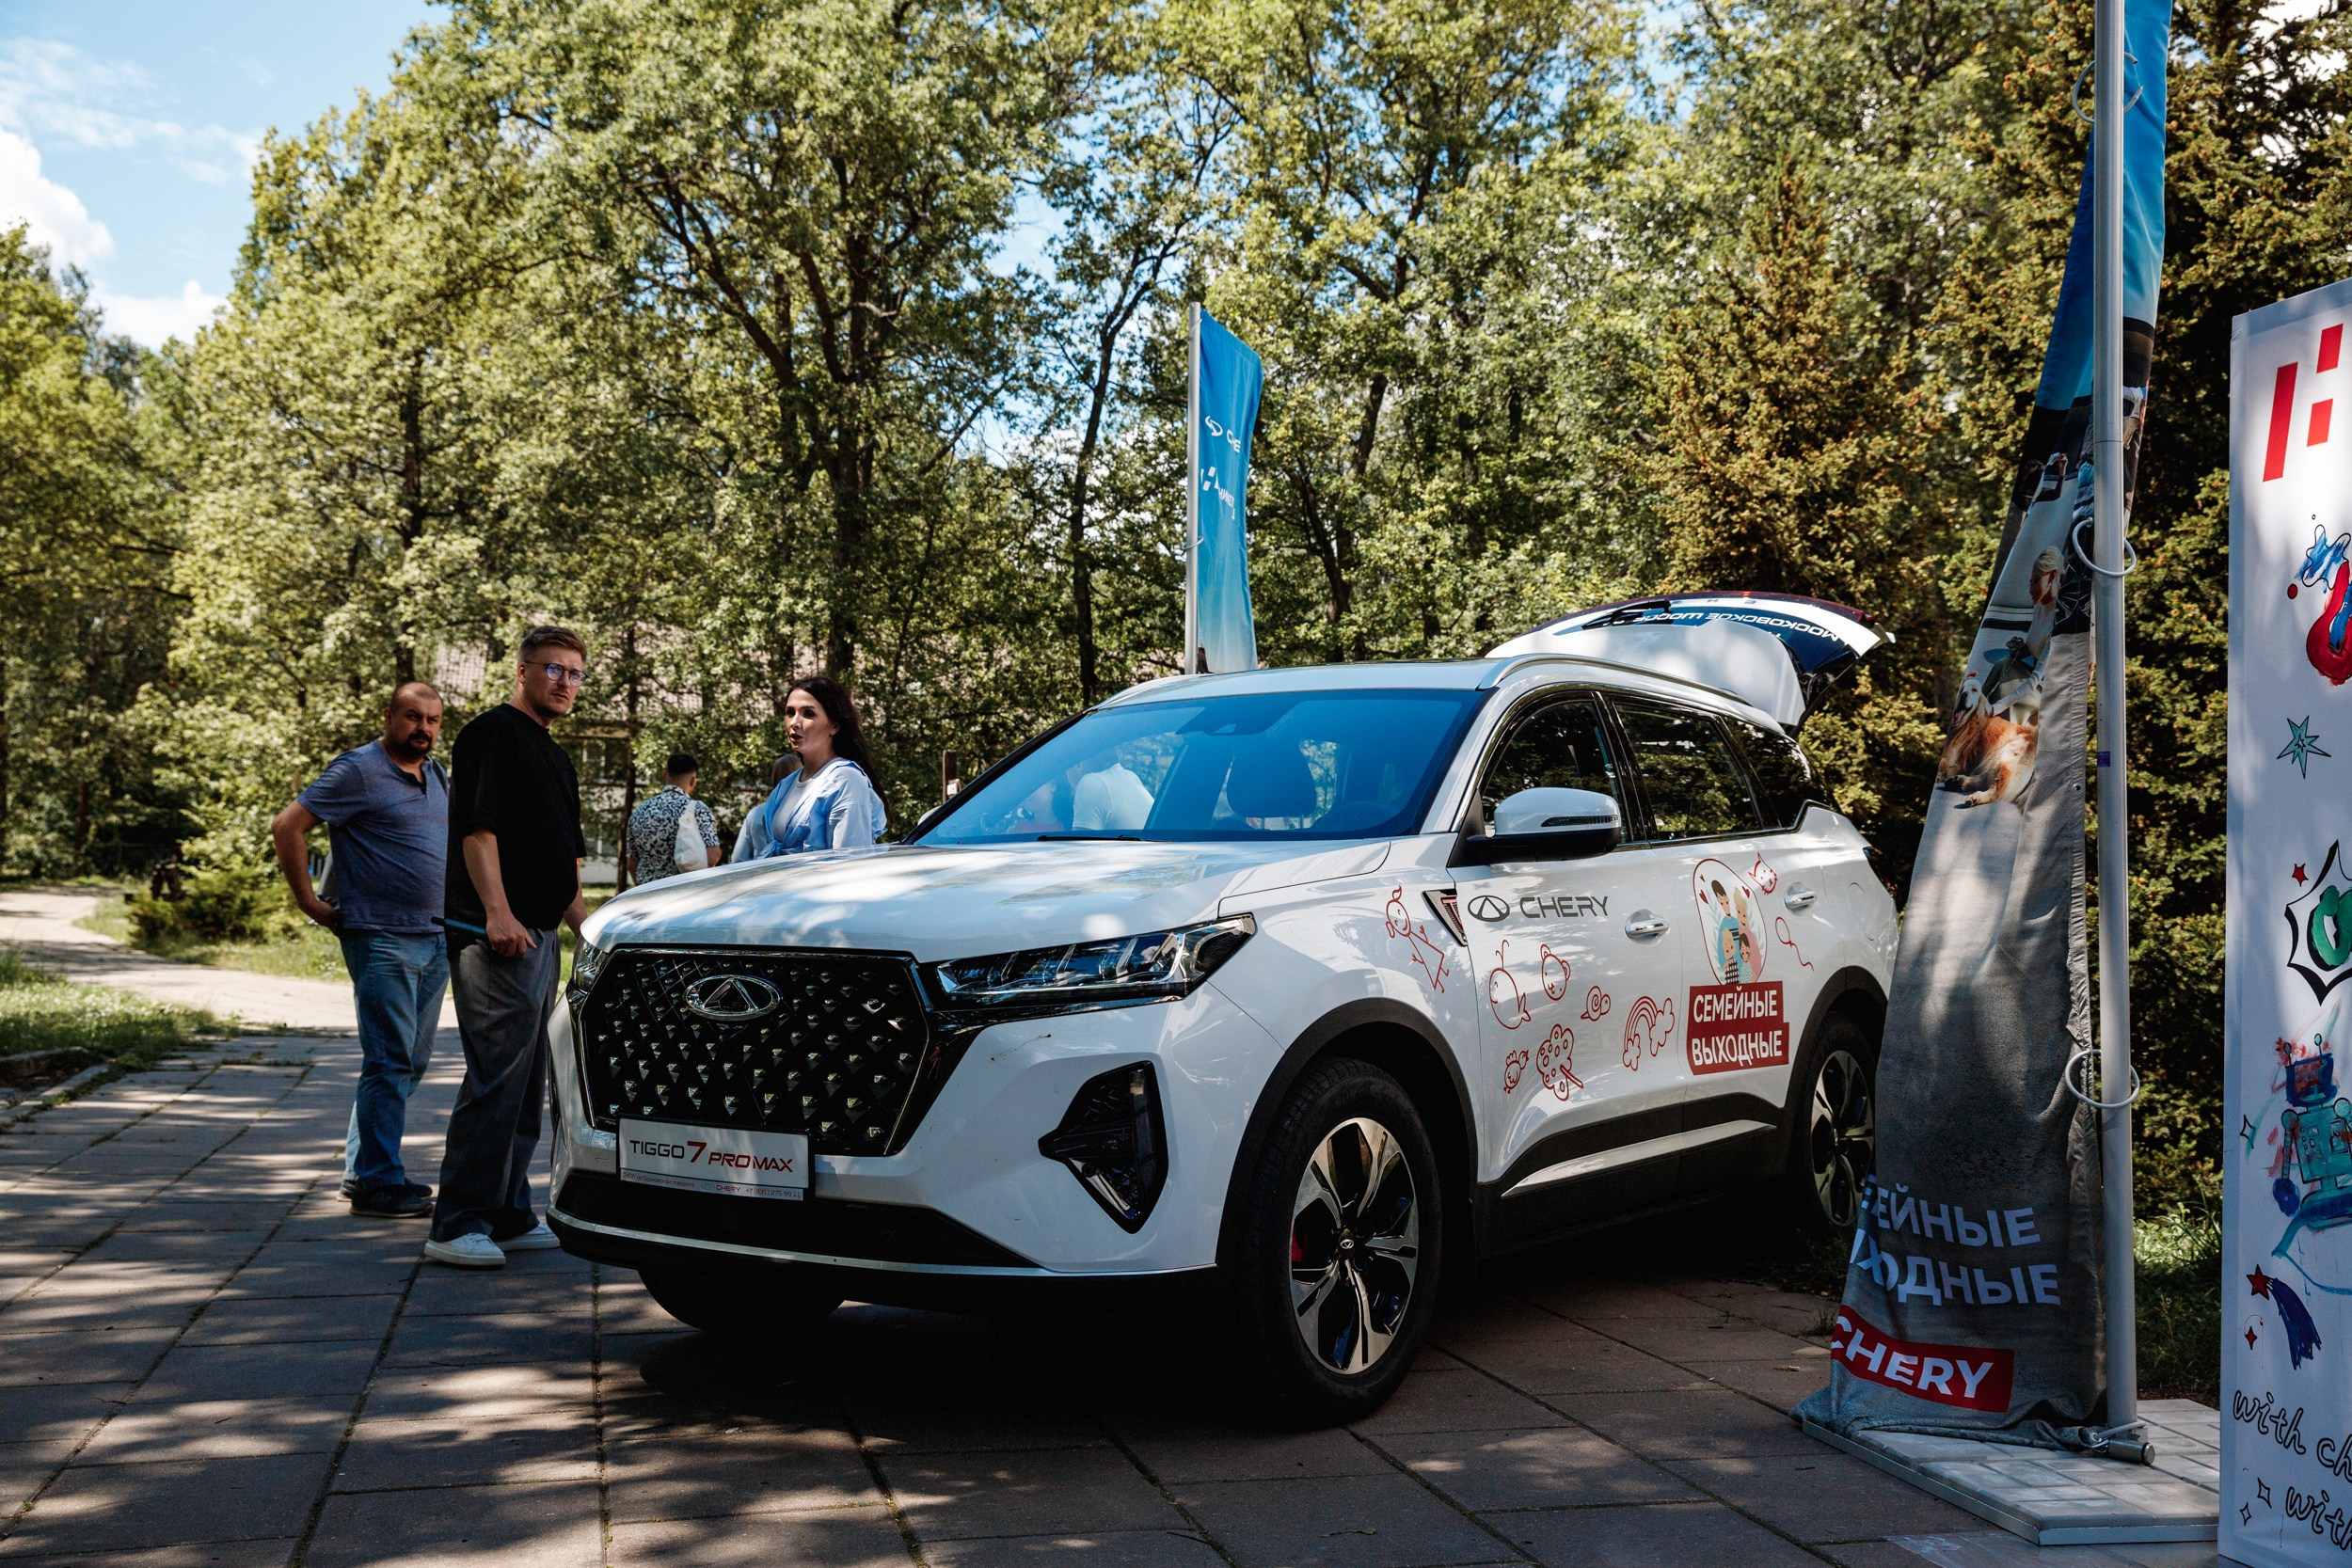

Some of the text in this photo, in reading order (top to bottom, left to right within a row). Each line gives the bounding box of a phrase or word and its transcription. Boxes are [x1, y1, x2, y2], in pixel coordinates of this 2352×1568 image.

[1705, 612, 1839, 641] МОСКОВСКОЕ
[1519, 895, 1608, 919] CHERY
[1692, 986, 1778, 1023] СЕМЕЙНЫЕ
[1692, 1030, 1783, 1068] ВЫХОДНЫЕ
[629, 1139, 793, 1173] TIGGO 7 PRO MAX
[716, 1184, 740, 1193] CHERY
[2233, 1389, 2306, 1455] with
